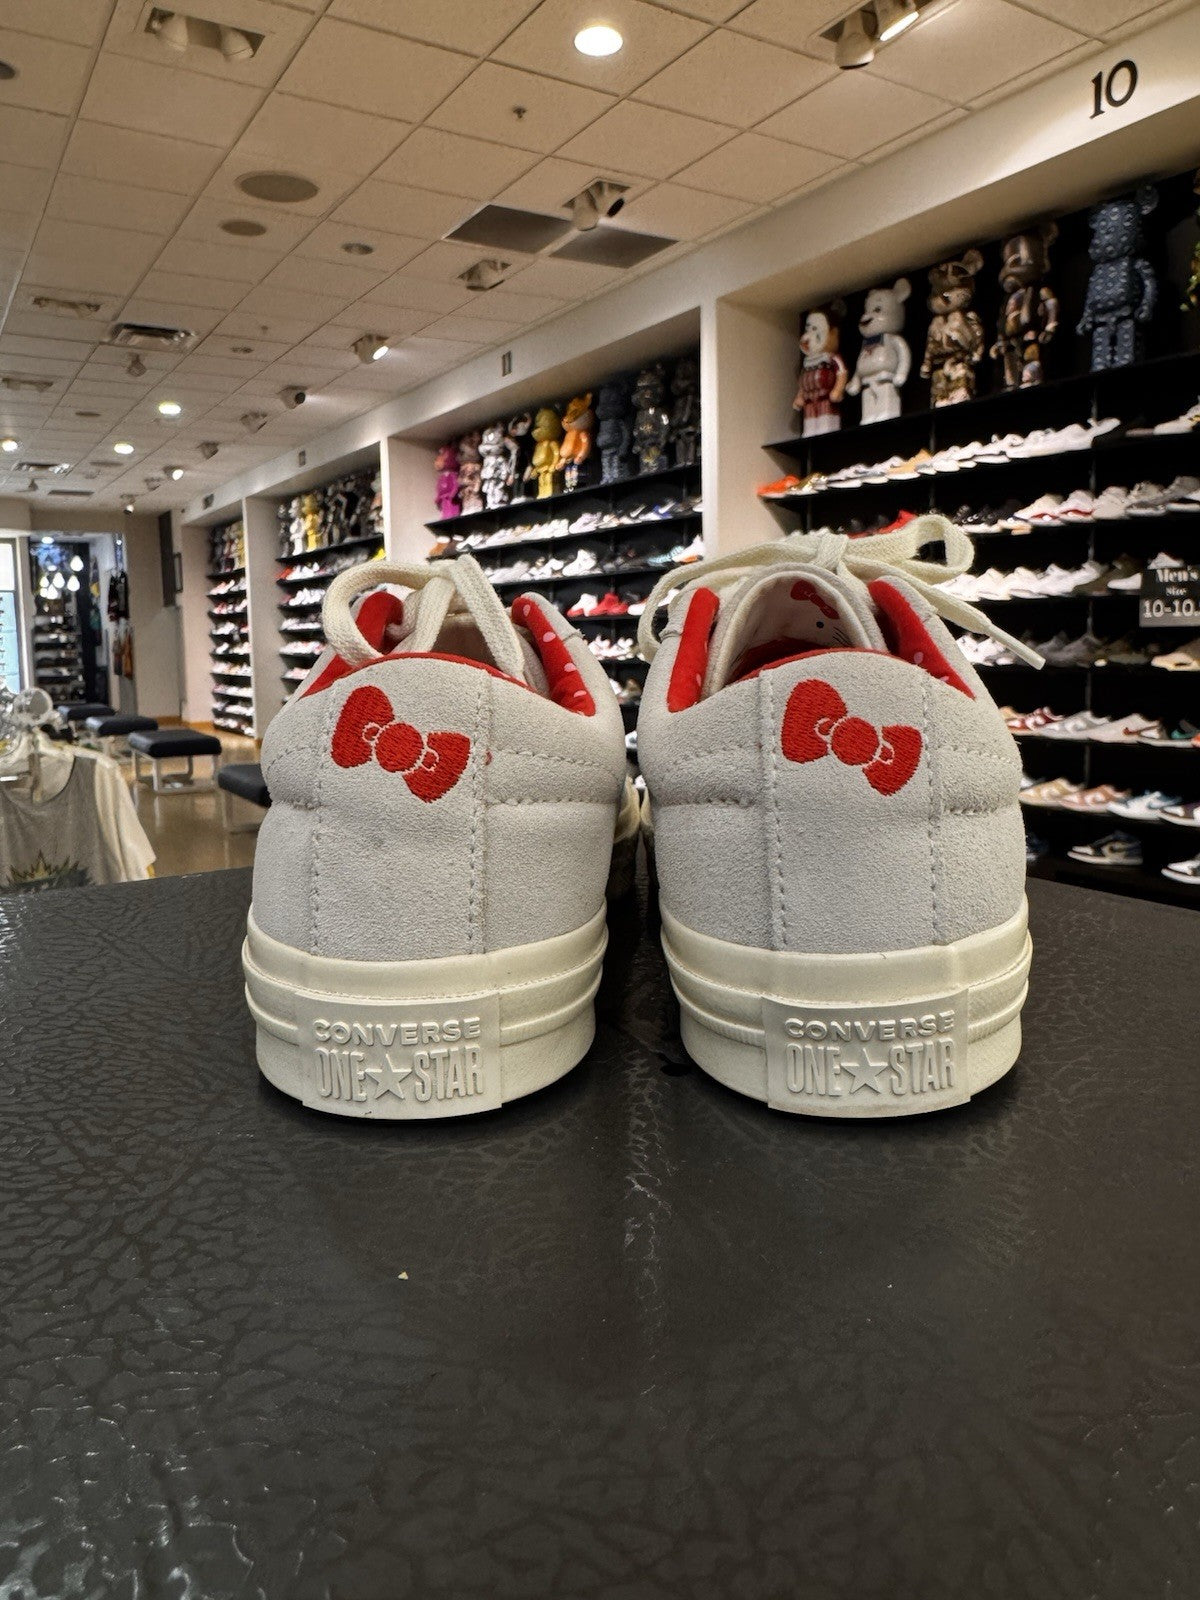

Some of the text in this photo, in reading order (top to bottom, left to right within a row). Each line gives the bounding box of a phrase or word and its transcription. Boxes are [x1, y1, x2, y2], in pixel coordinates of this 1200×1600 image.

[1089, 59, 1138, 119] 10
[1143, 598, 1200, 618] 10-10.
[312, 1016, 482, 1046] CONVERSE
[785, 1009, 955, 1042] CONVERSE
[314, 1043, 484, 1102] ONE STAR
[786, 1037, 955, 1097] ONE STAR
